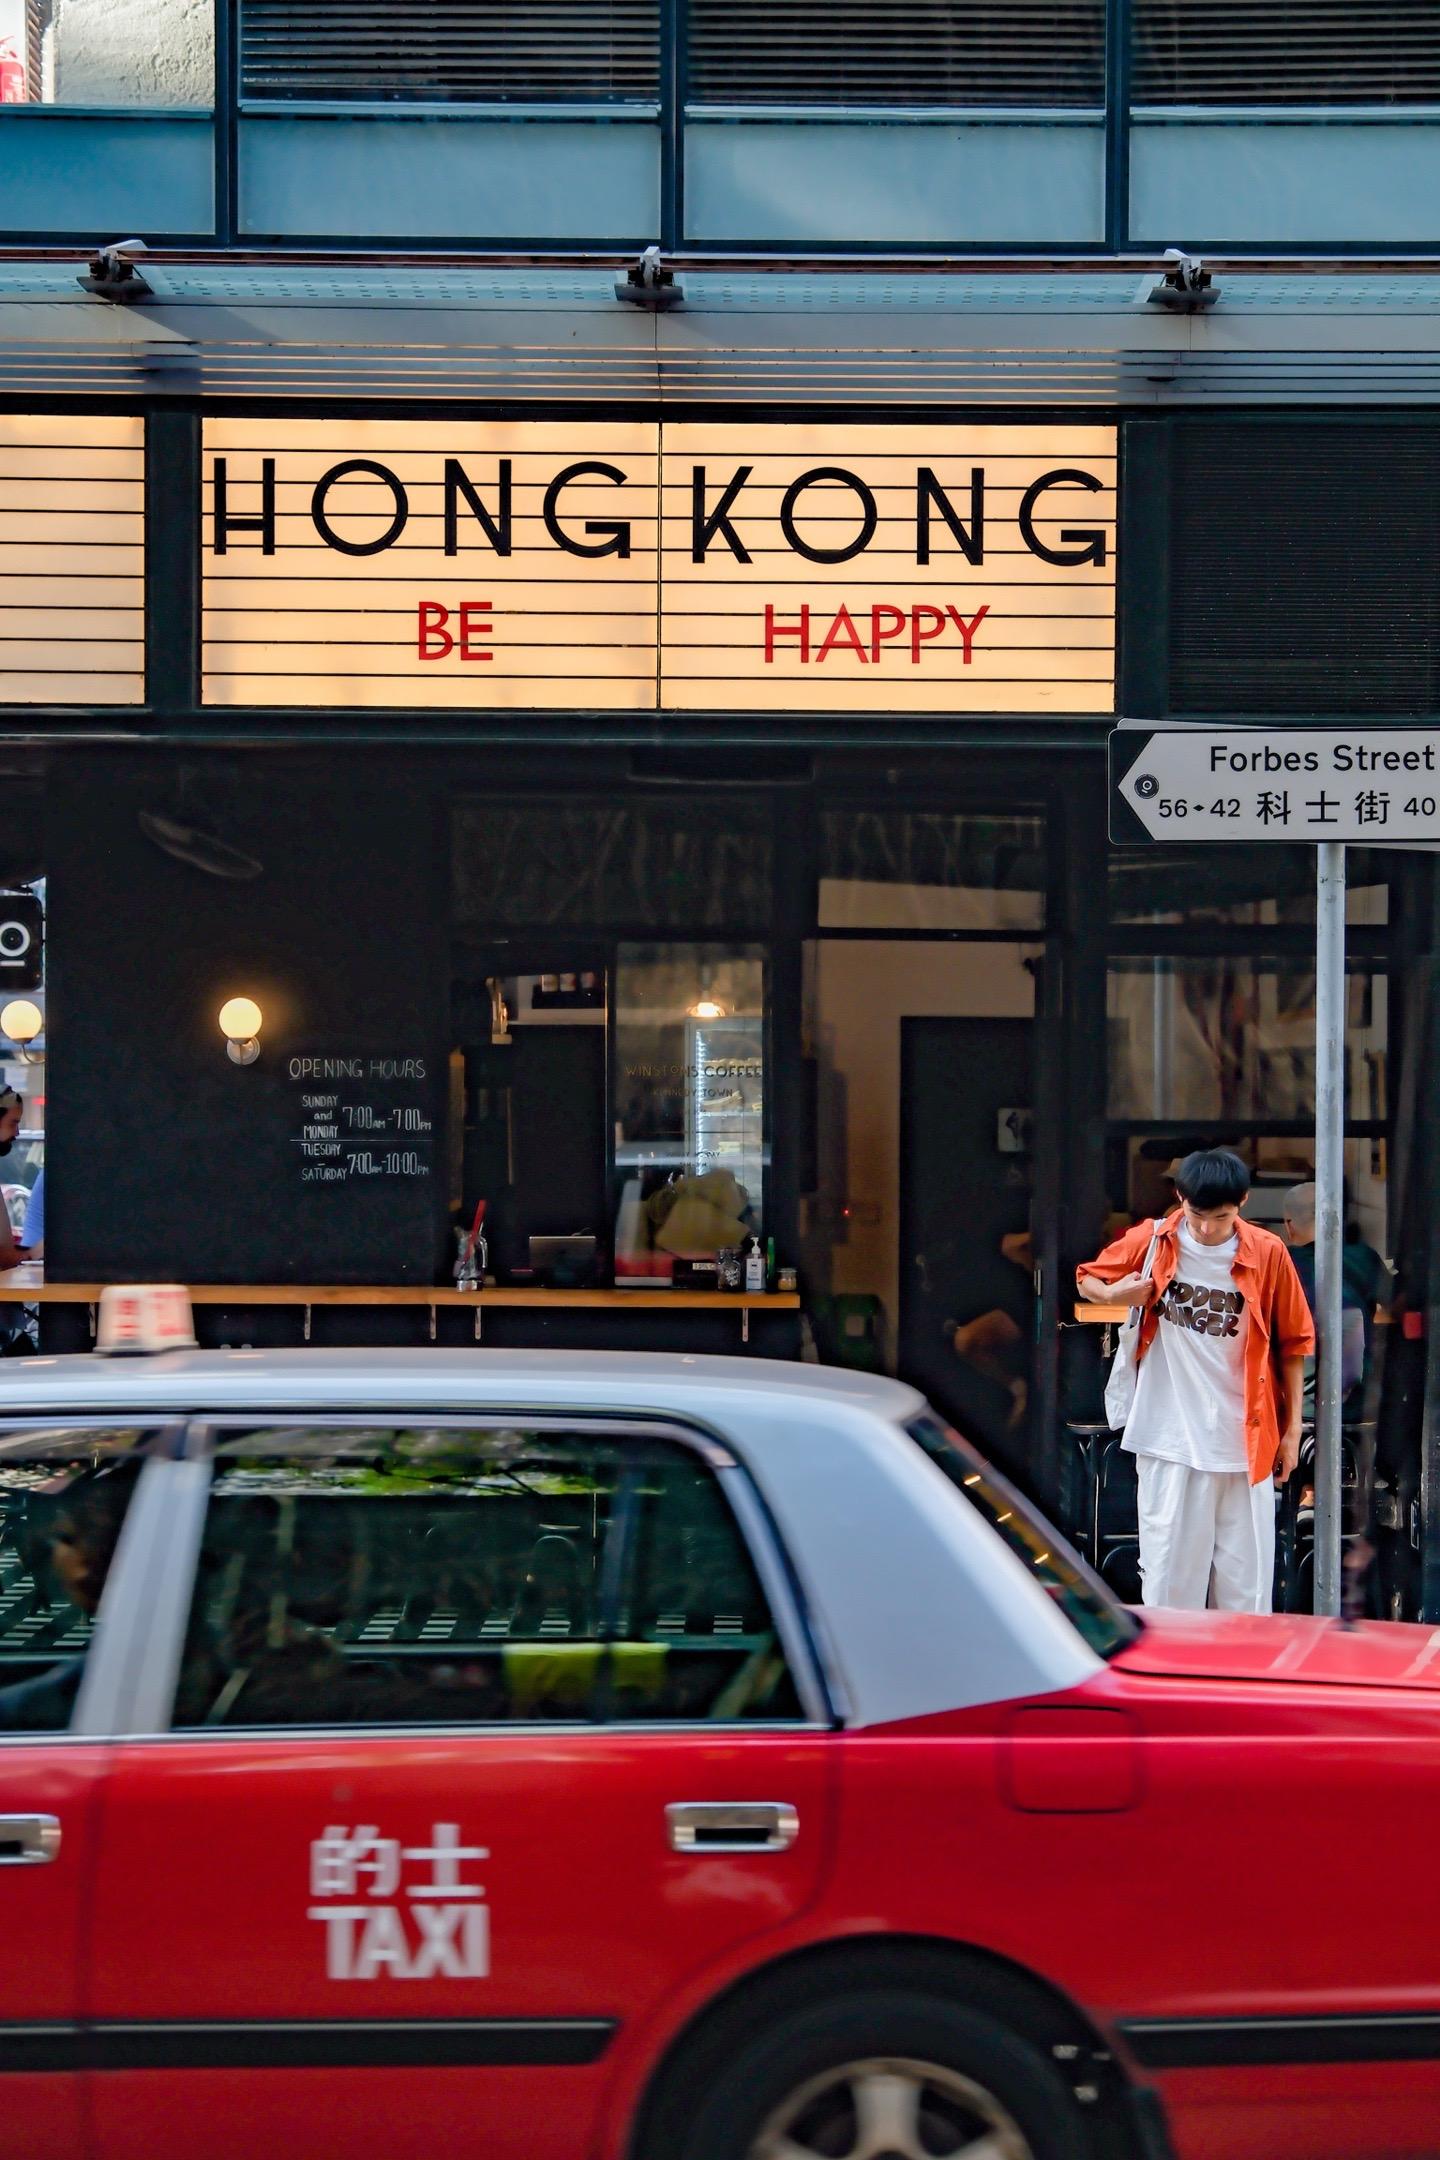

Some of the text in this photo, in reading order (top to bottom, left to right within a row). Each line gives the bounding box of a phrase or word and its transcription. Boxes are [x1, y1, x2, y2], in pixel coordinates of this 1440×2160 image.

[214, 457, 1106, 567] HONG KONG
[418, 601, 991, 664] BE HAPPY
[1210, 744, 1436, 772] Forbes Street
[1256, 790, 1390, 826] 科士街
[1403, 796, 1437, 817] 40
[289, 1058, 426, 1080] OPENING HOURS
[704, 1065, 762, 1078] COFFEE
[302, 1095, 339, 1108] SUNDAY
[703, 1088, 733, 1097] TOWN
[313, 1110, 333, 1120] and
[303, 1125, 339, 1139] MONDAY
[301, 1143, 341, 1156] TUESDAY
[302, 1168, 348, 1181] SATURDAY
[309, 1822, 491, 1897] 的士
[306, 1904, 491, 1980] TAXI
